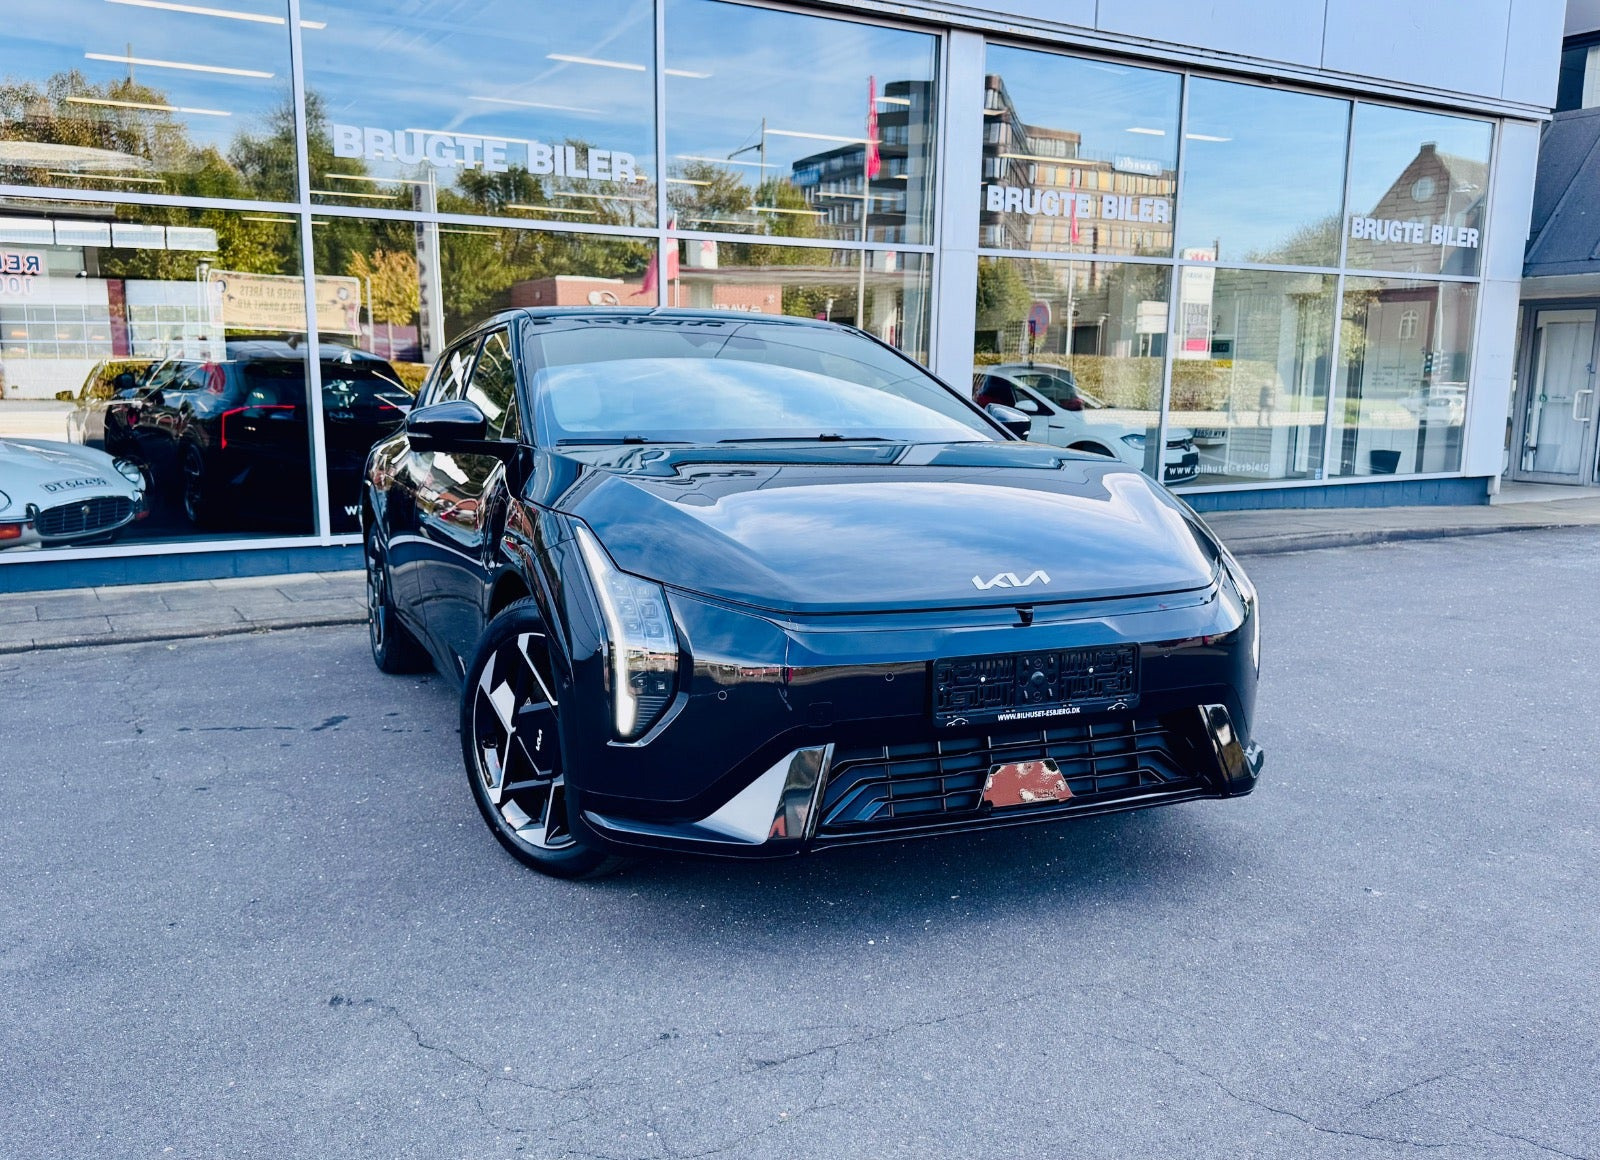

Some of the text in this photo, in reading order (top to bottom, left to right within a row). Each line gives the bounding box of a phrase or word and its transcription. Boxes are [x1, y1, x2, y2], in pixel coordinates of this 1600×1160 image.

[332, 123, 637, 183] BRUGTE BILER
[987, 184, 1169, 224] BRUGTE BILER
[1351, 216, 1479, 249] BRUGTE BILER
[971, 569, 1051, 590] KIA
[997, 706, 1081, 722] WWW.BILHUSET-ESBJERG.DK
